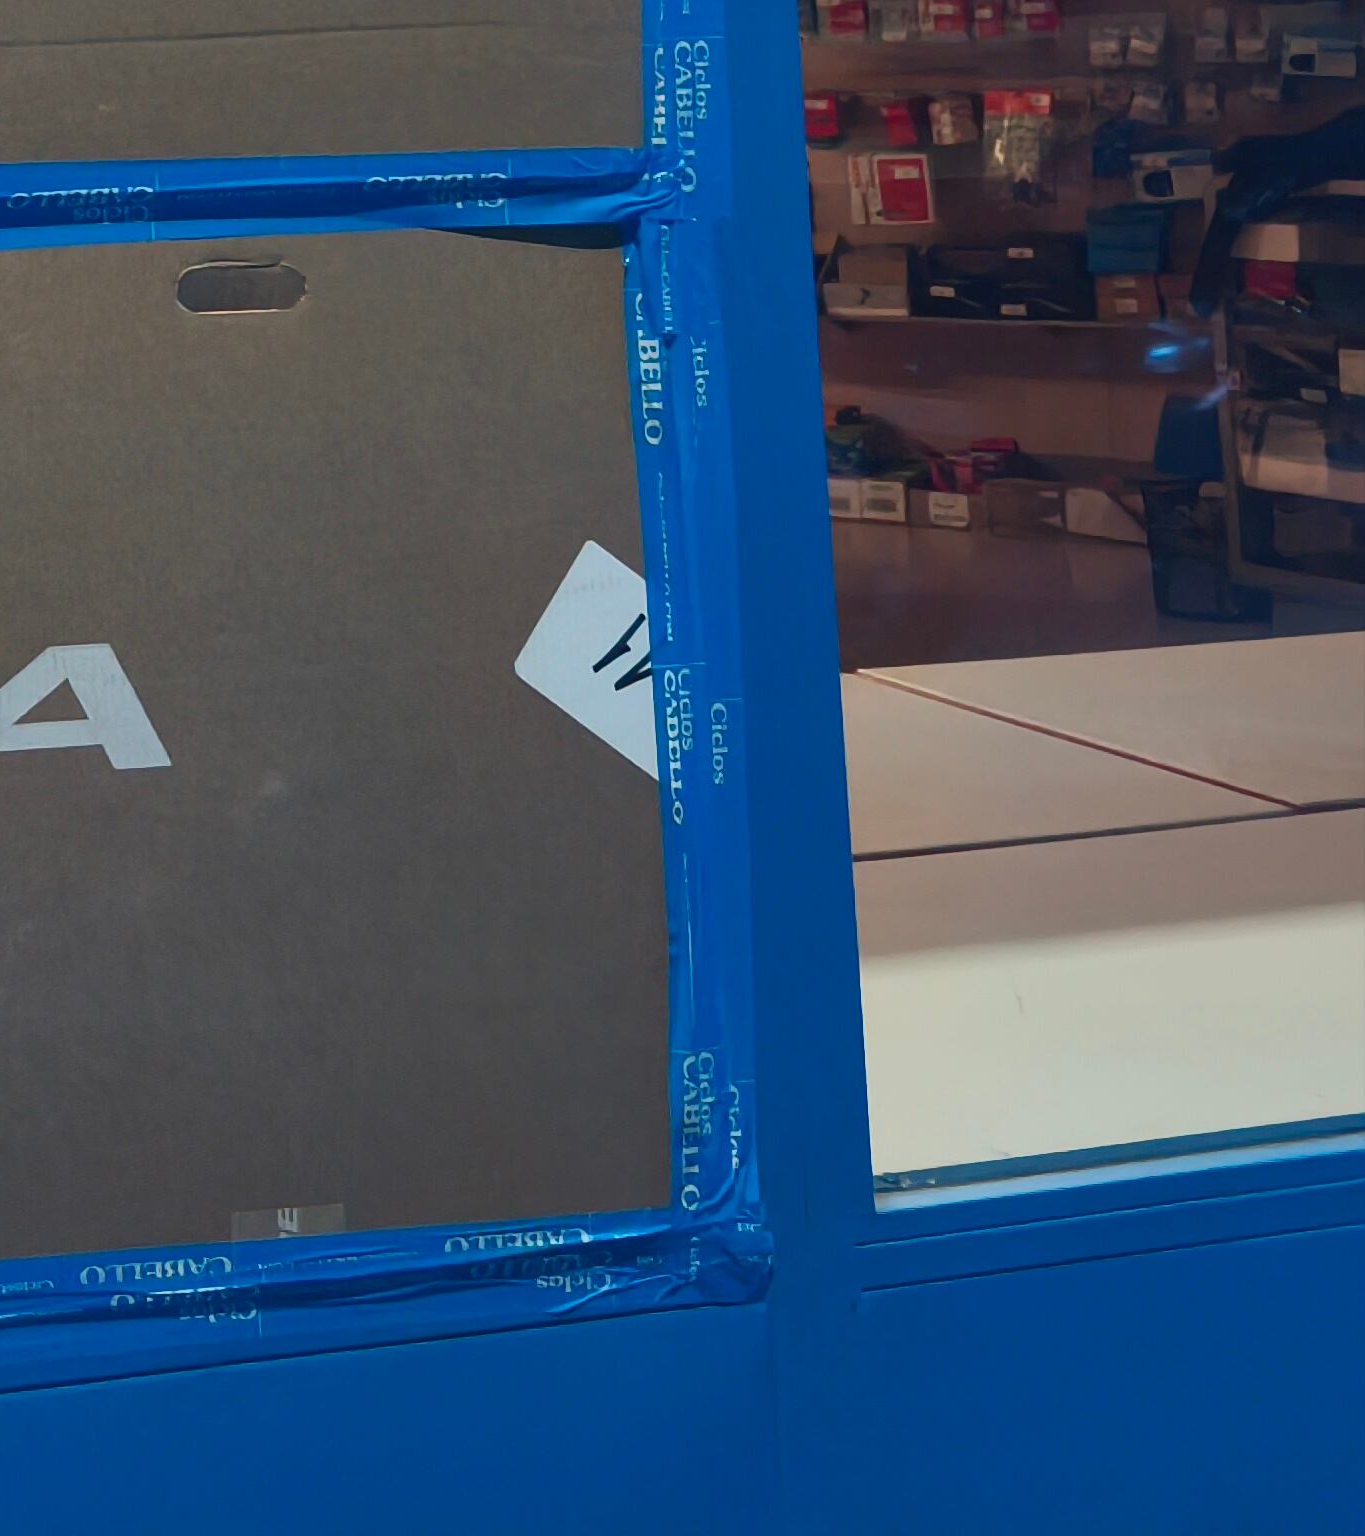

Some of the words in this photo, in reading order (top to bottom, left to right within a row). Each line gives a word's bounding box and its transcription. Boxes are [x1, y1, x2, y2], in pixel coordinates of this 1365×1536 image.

[692, 39, 714, 120] Ciclos
[710, 701, 730, 786] Ciclos
[680, 1053, 702, 1214] CABELLO
[697, 1050, 718, 1137] Ciclos
